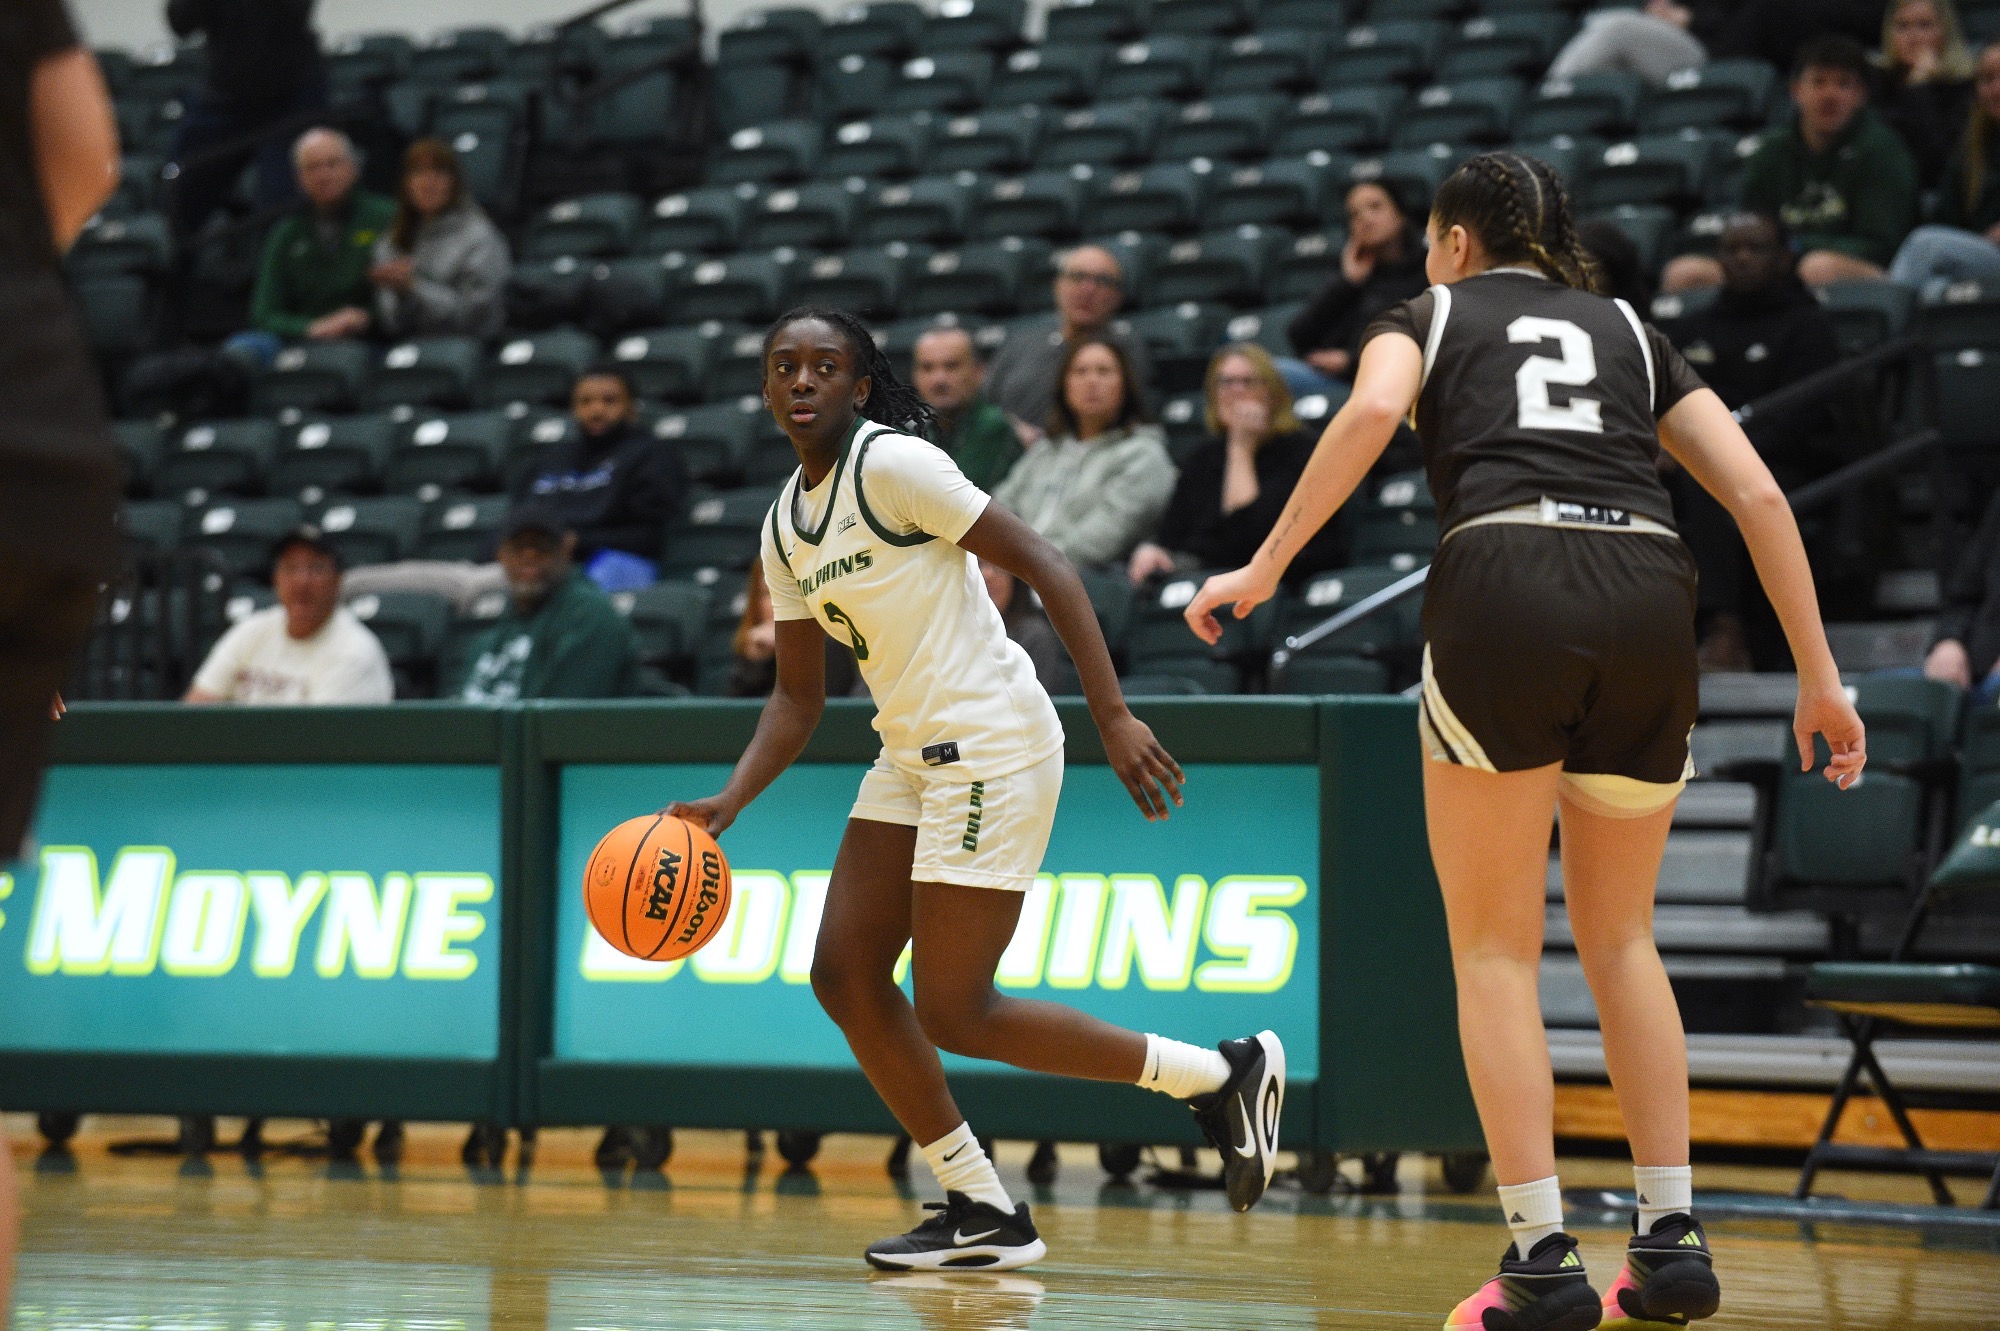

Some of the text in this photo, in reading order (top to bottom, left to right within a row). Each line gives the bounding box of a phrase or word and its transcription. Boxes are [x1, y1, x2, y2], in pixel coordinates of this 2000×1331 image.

[1507, 315, 1603, 434] 2
[837, 512, 857, 536] NEC
[944, 747, 953, 757] M
[25, 845, 494, 980] MOYNE
[644, 847, 682, 920] NCAA
[677, 850, 720, 943] Wilson
